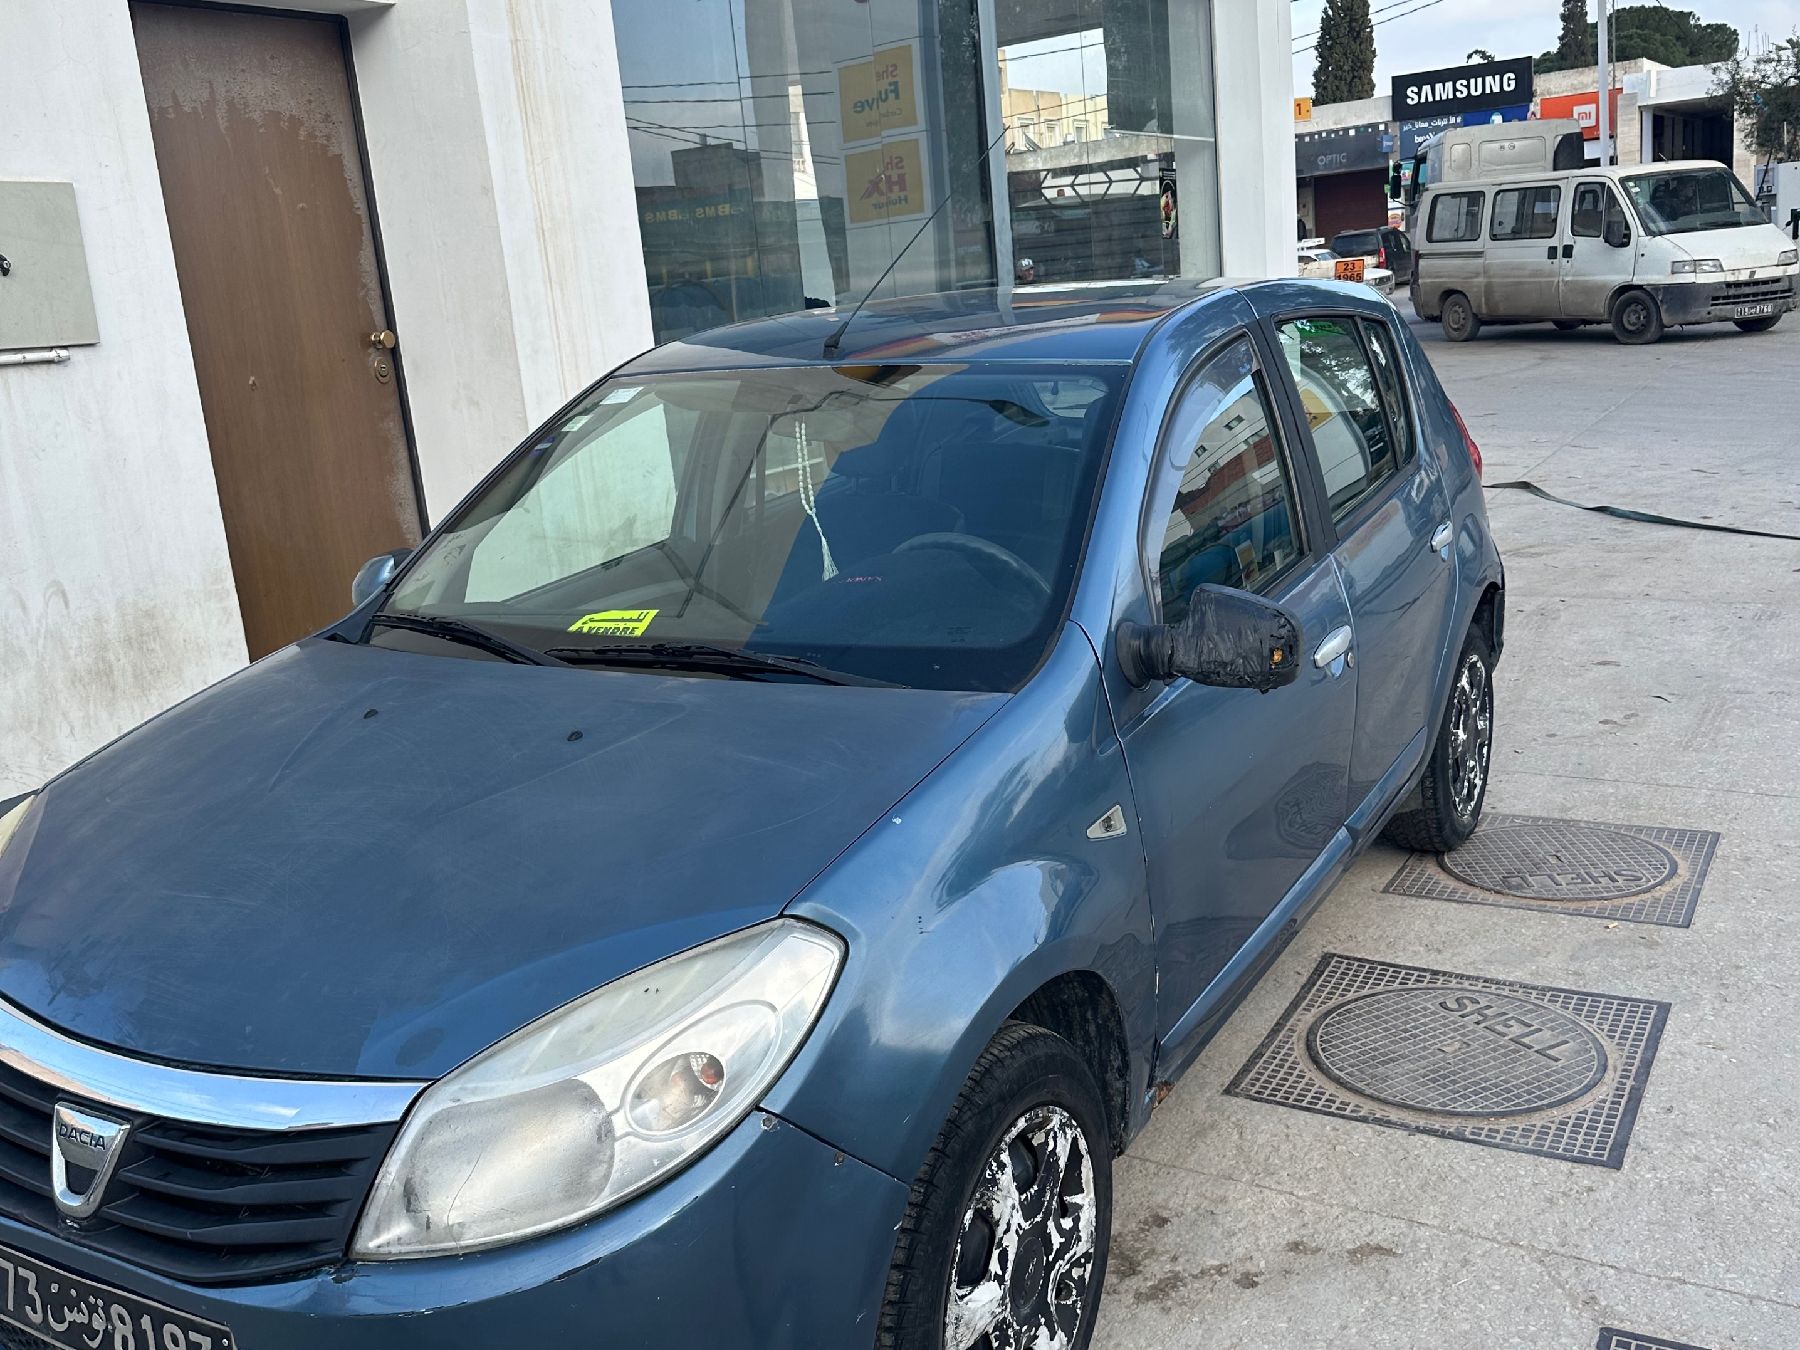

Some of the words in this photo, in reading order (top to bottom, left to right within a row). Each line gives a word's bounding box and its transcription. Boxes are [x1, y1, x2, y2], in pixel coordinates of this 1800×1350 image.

[1406, 73, 1516, 105] SAMSUNG
[1317, 153, 1347, 166] OPTIC
[1343, 262, 1356, 272] 23
[1501, 868, 1645, 888] SHELL
[1439, 995, 1570, 1062] SHELL
[59, 1123, 106, 1150] DACIA
